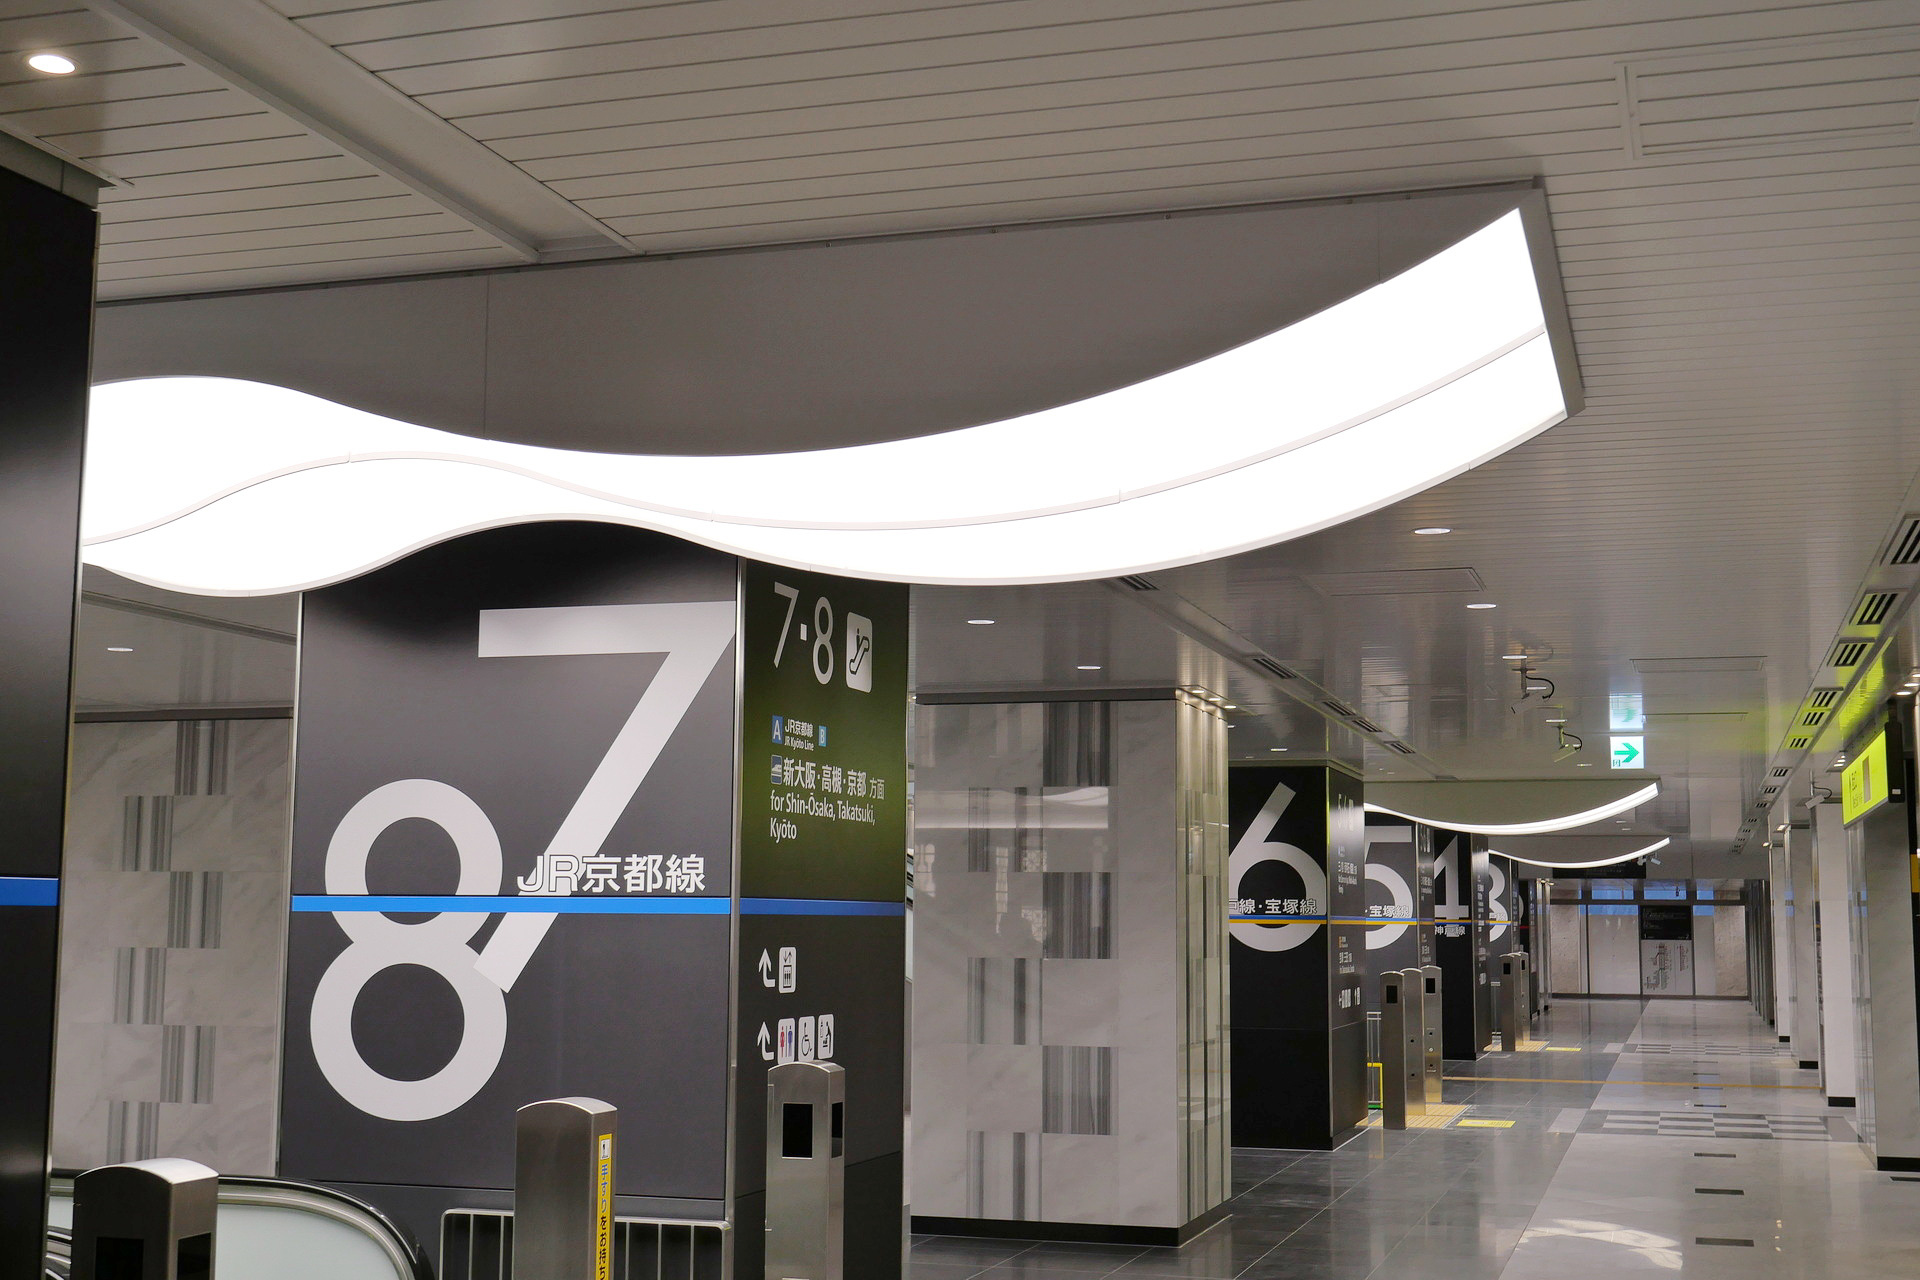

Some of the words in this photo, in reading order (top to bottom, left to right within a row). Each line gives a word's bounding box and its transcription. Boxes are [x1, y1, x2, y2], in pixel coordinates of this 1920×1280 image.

[773, 719, 781, 741] A
[784, 736, 790, 746] JR
[804, 739, 814, 751] Line
[785, 719, 813, 737] JR京都線
[473, 601, 736, 993] 7
[869, 777, 885, 800] 方面
[770, 789, 784, 812] for
[786, 792, 836, 821] Shin-Ōsaka,
[837, 800, 876, 826] Takatsuki,
[770, 817, 797, 844] Kyōto
[517, 854, 706, 893] JR京都線
[1229, 782, 1327, 952] 6
[1364, 826, 1413, 950] 5
[310, 779, 507, 1122] 8
